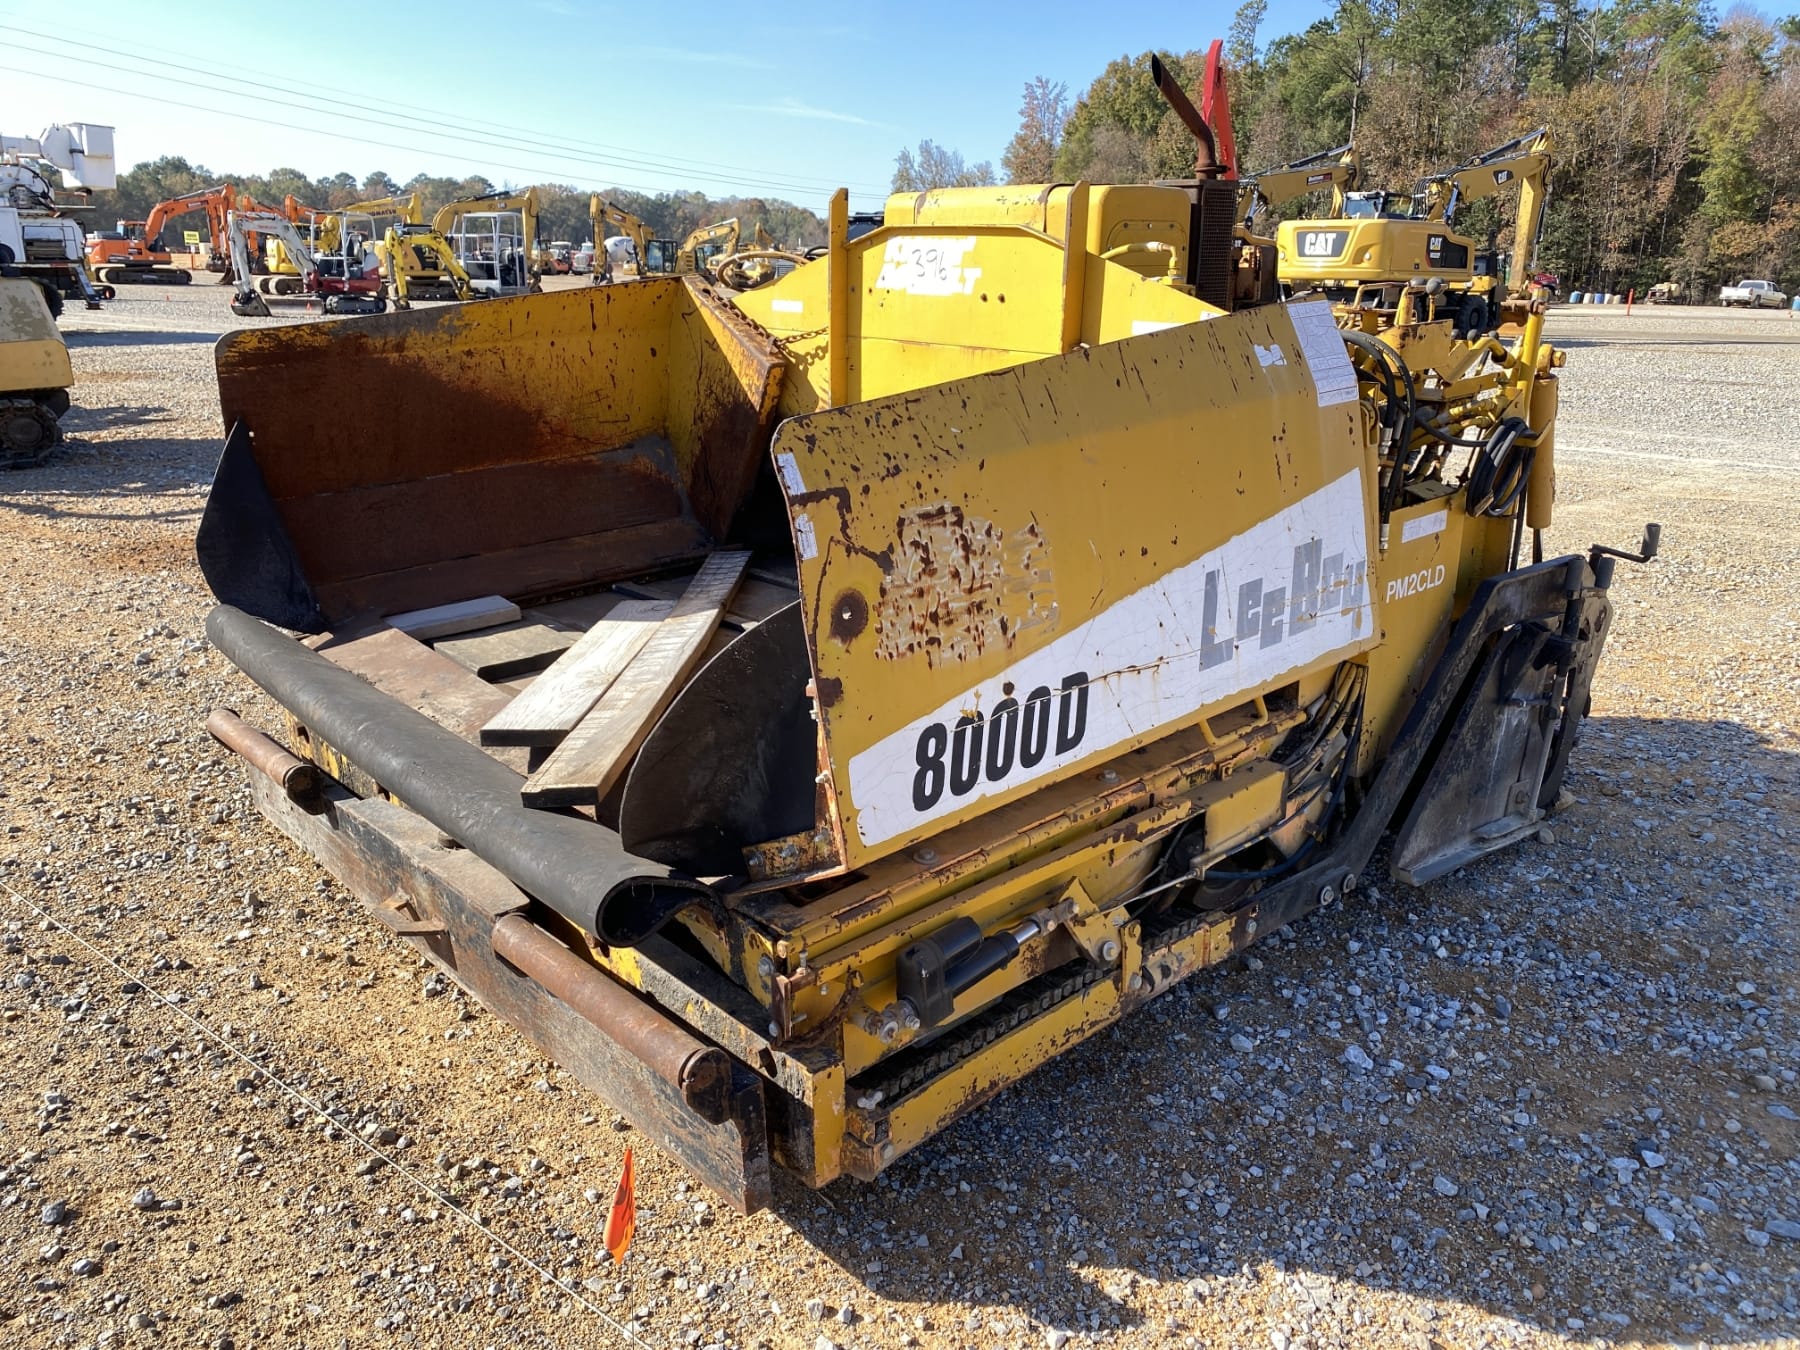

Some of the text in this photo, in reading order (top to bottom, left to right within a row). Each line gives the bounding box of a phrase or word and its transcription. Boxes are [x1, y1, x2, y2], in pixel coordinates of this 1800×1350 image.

[1305, 233, 1336, 256] CAT
[1430, 237, 1443, 251] CAT
[912, 249, 947, 280] 396
[1386, 564, 1446, 604] PM2CLD
[912, 671, 1089, 812] 8000D
